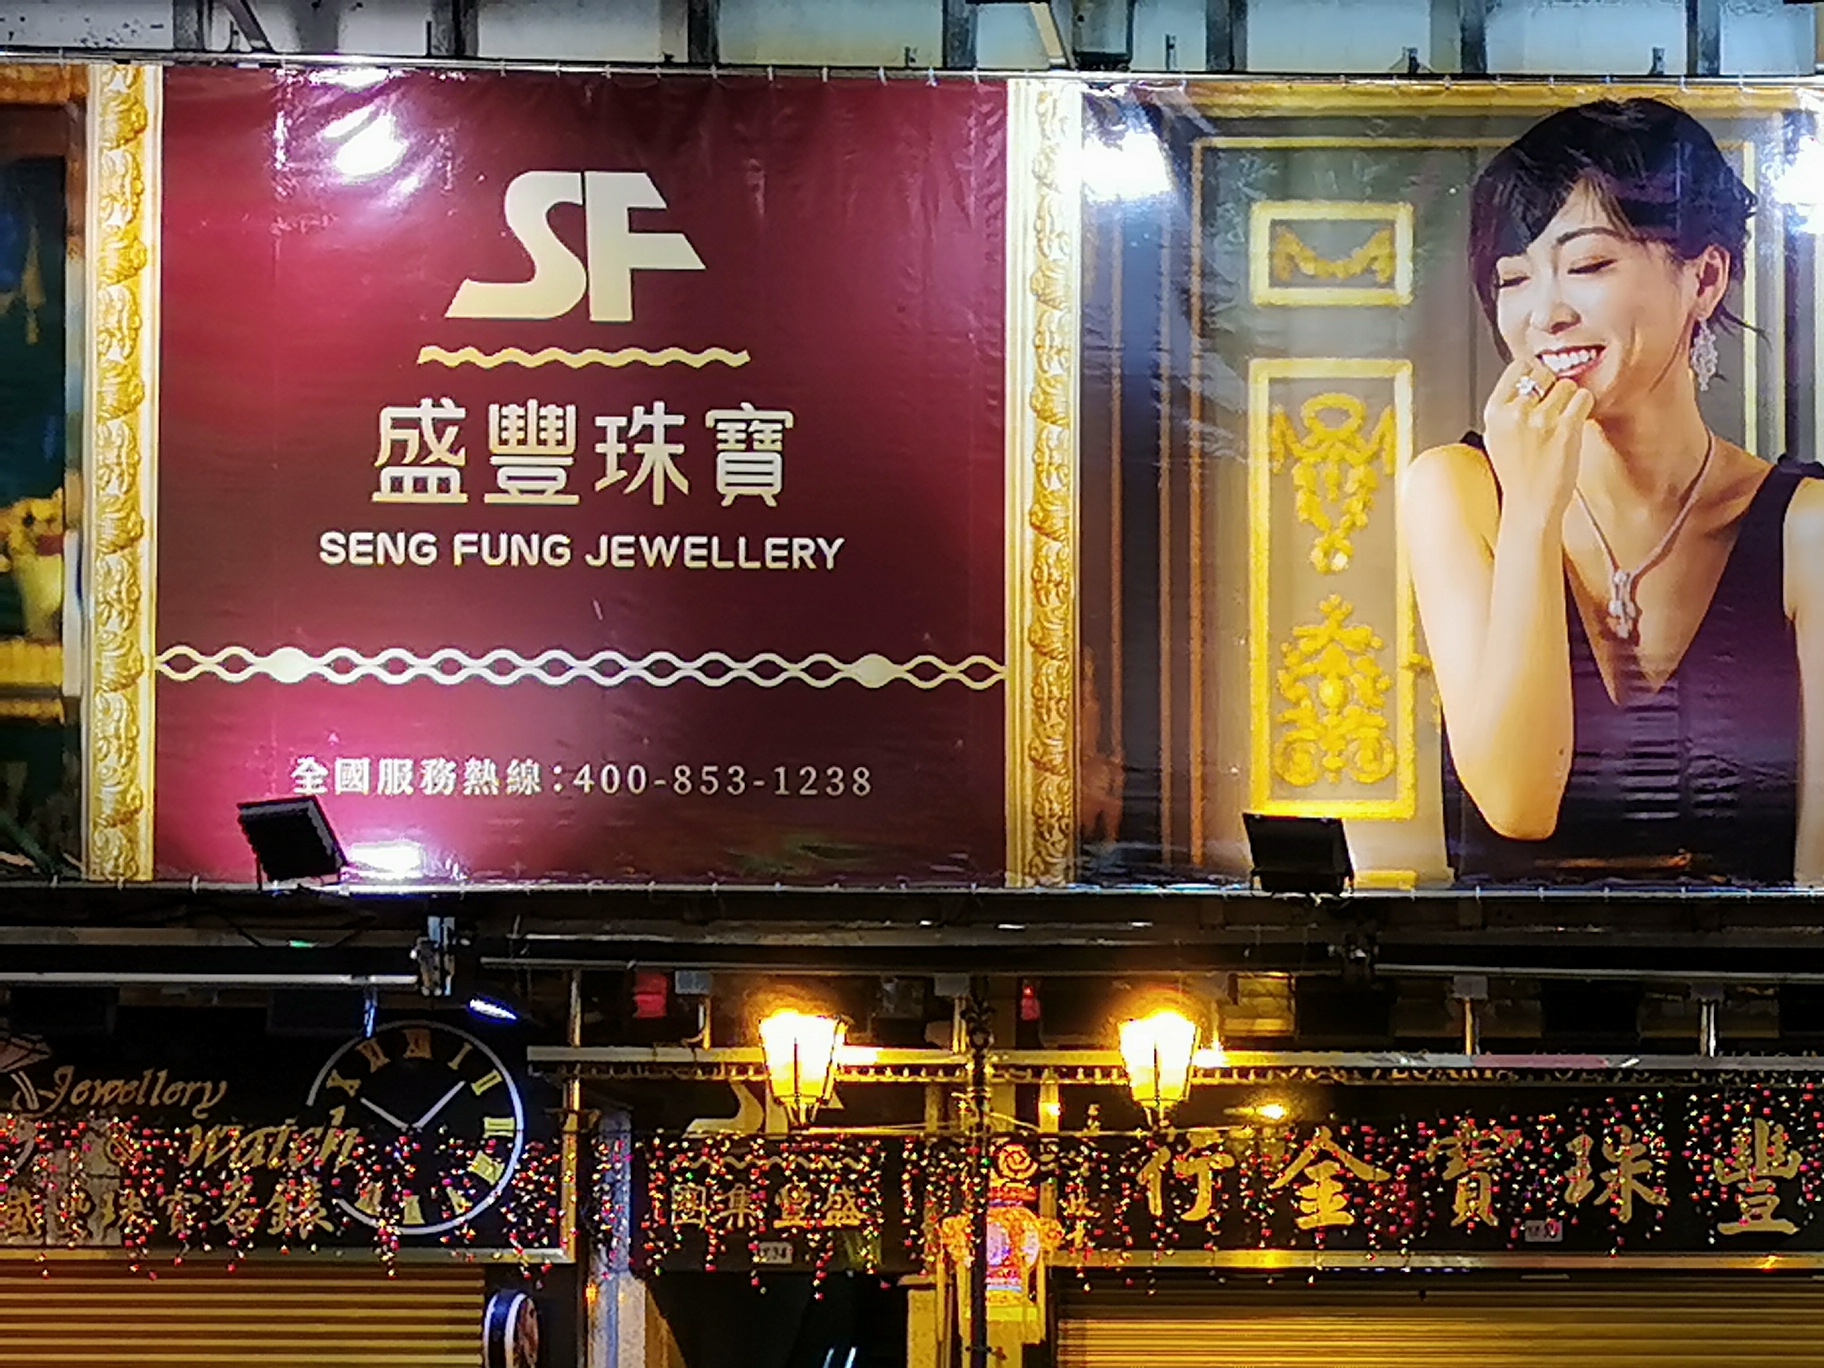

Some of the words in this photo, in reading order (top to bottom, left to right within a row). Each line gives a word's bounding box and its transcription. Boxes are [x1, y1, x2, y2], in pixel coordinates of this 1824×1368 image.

[445, 170, 707, 323] SF
[371, 397, 795, 508] 盛豐珠寶
[319, 530, 438, 567] SENG
[453, 531, 571, 568] FUNG
[584, 532, 846, 571] JEWELLERY
